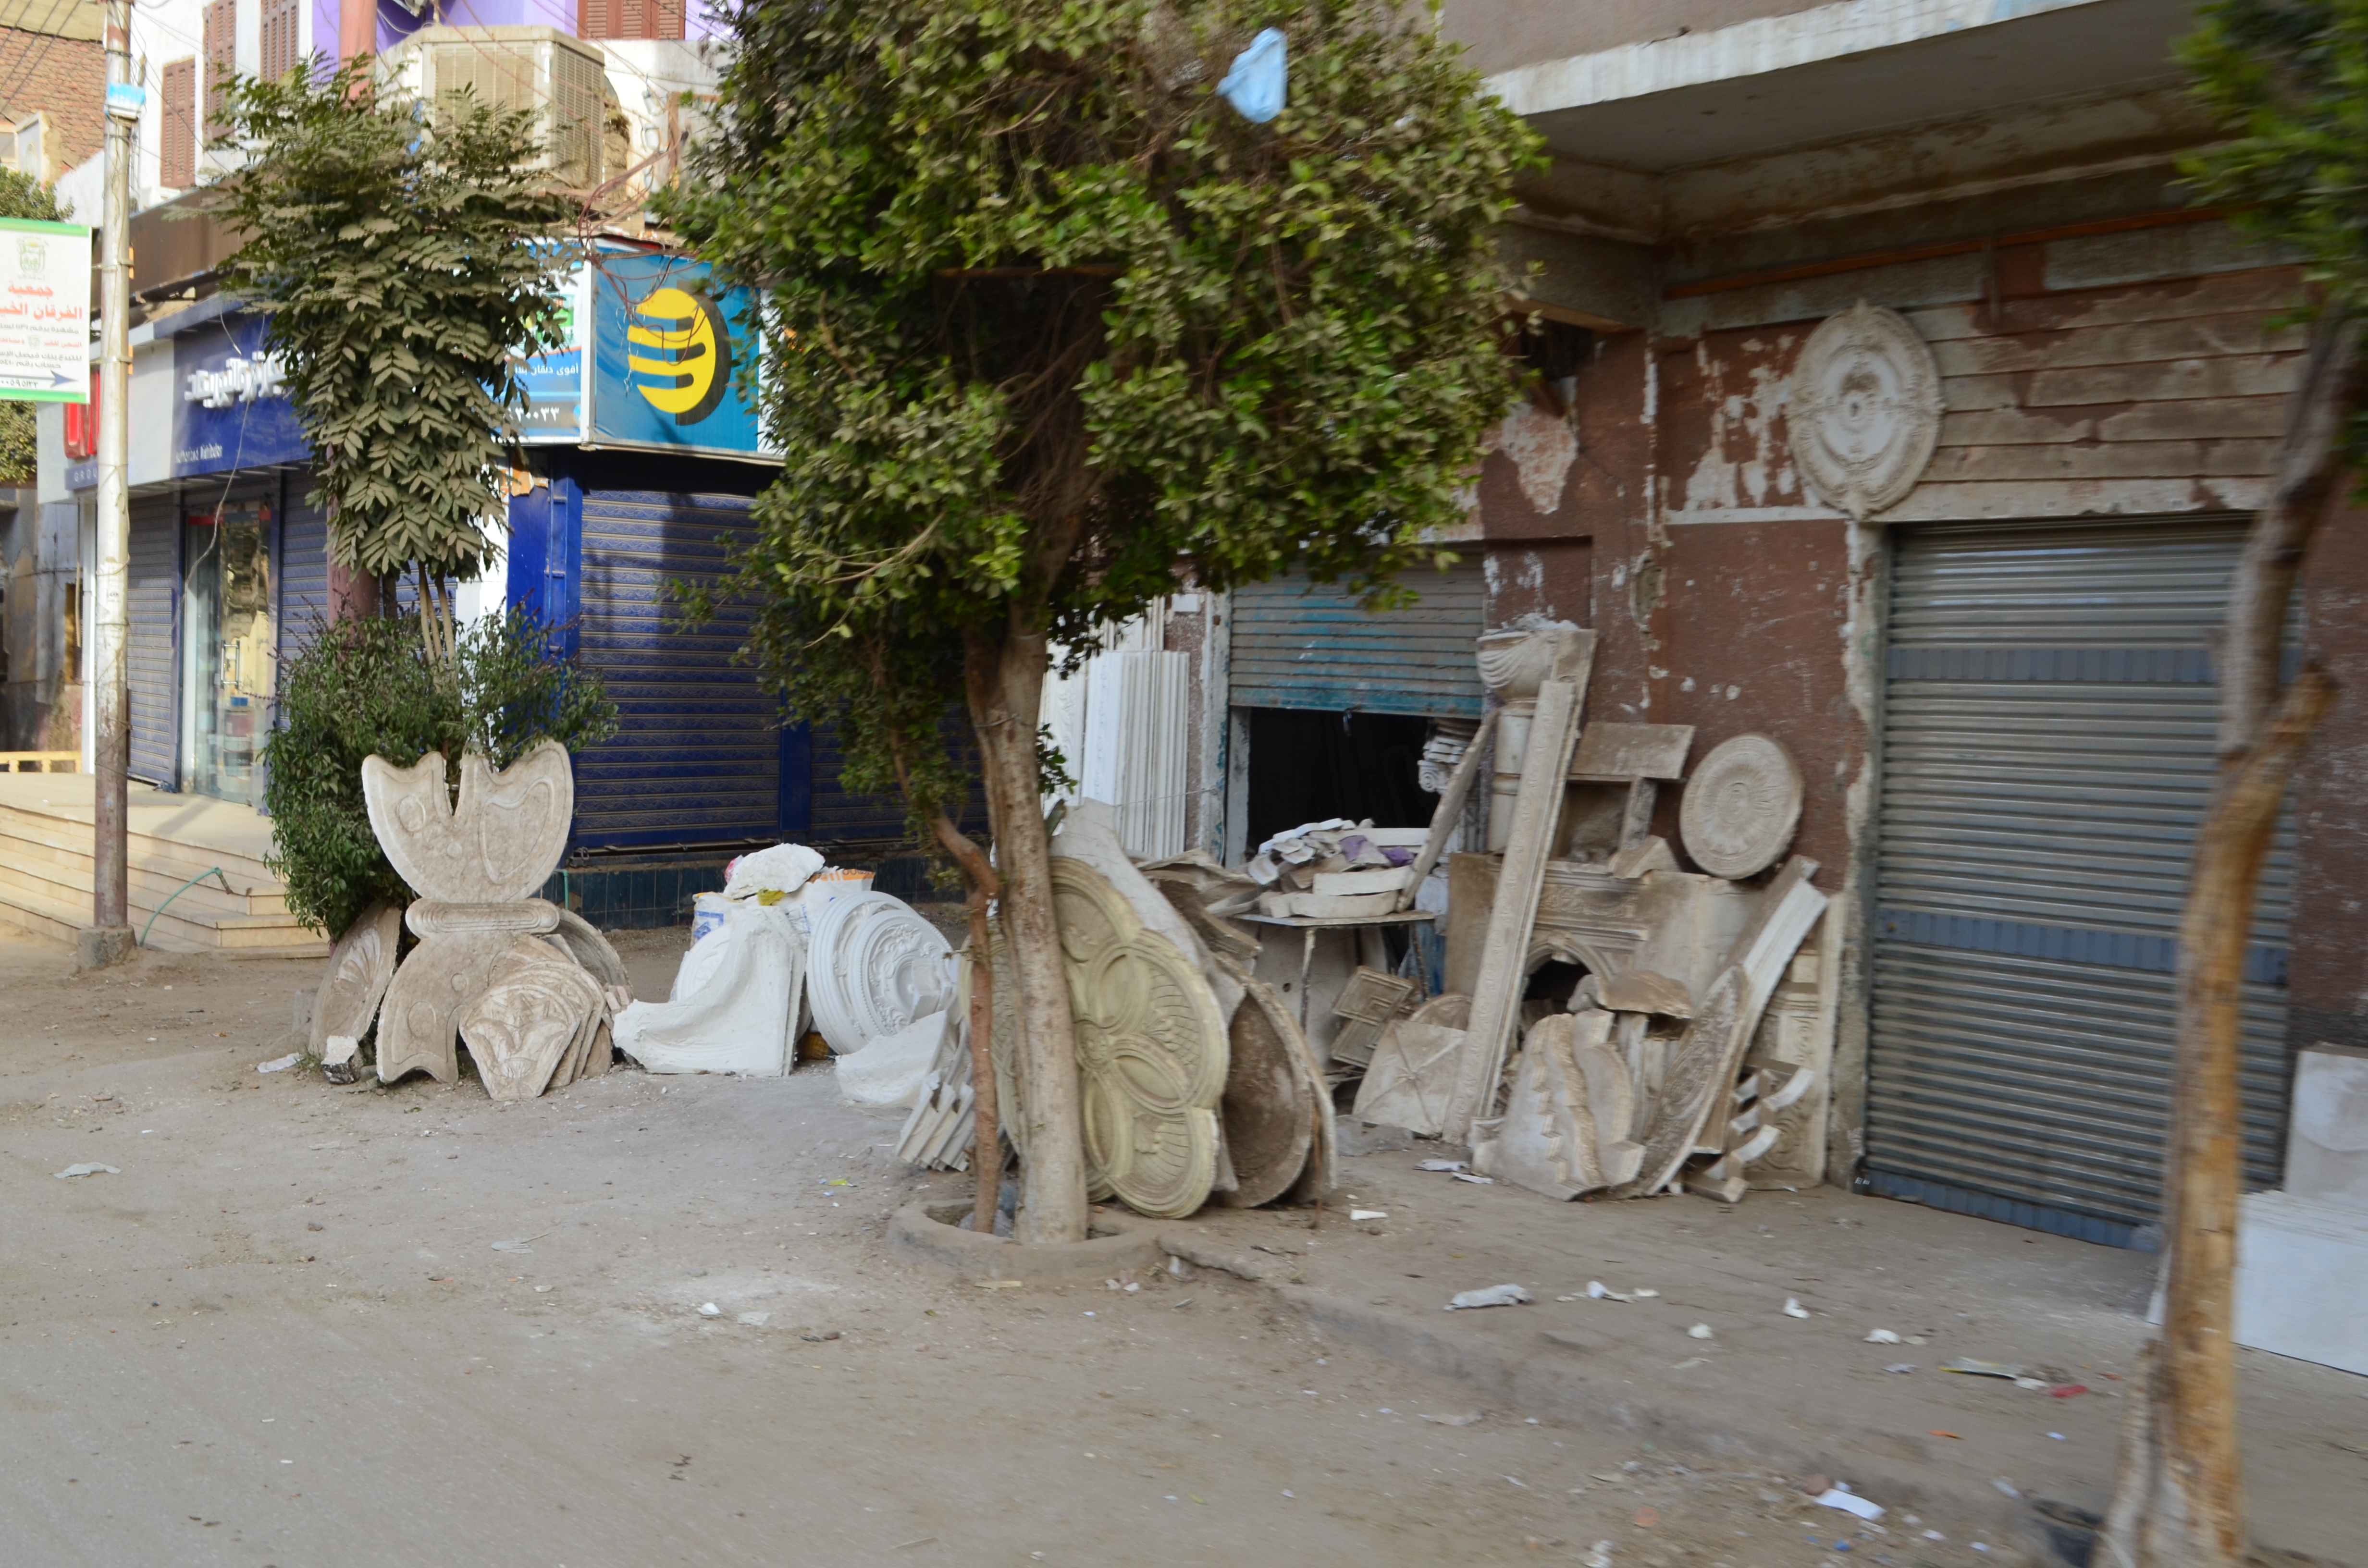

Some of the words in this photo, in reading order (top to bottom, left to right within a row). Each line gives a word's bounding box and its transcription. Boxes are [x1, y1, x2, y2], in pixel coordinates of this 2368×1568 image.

[8, 281, 54, 299] جمعية
[0, 301, 28, 317] الخي
[33, 304, 83, 321] الفرقان
[74, 467, 98, 482] GROU
